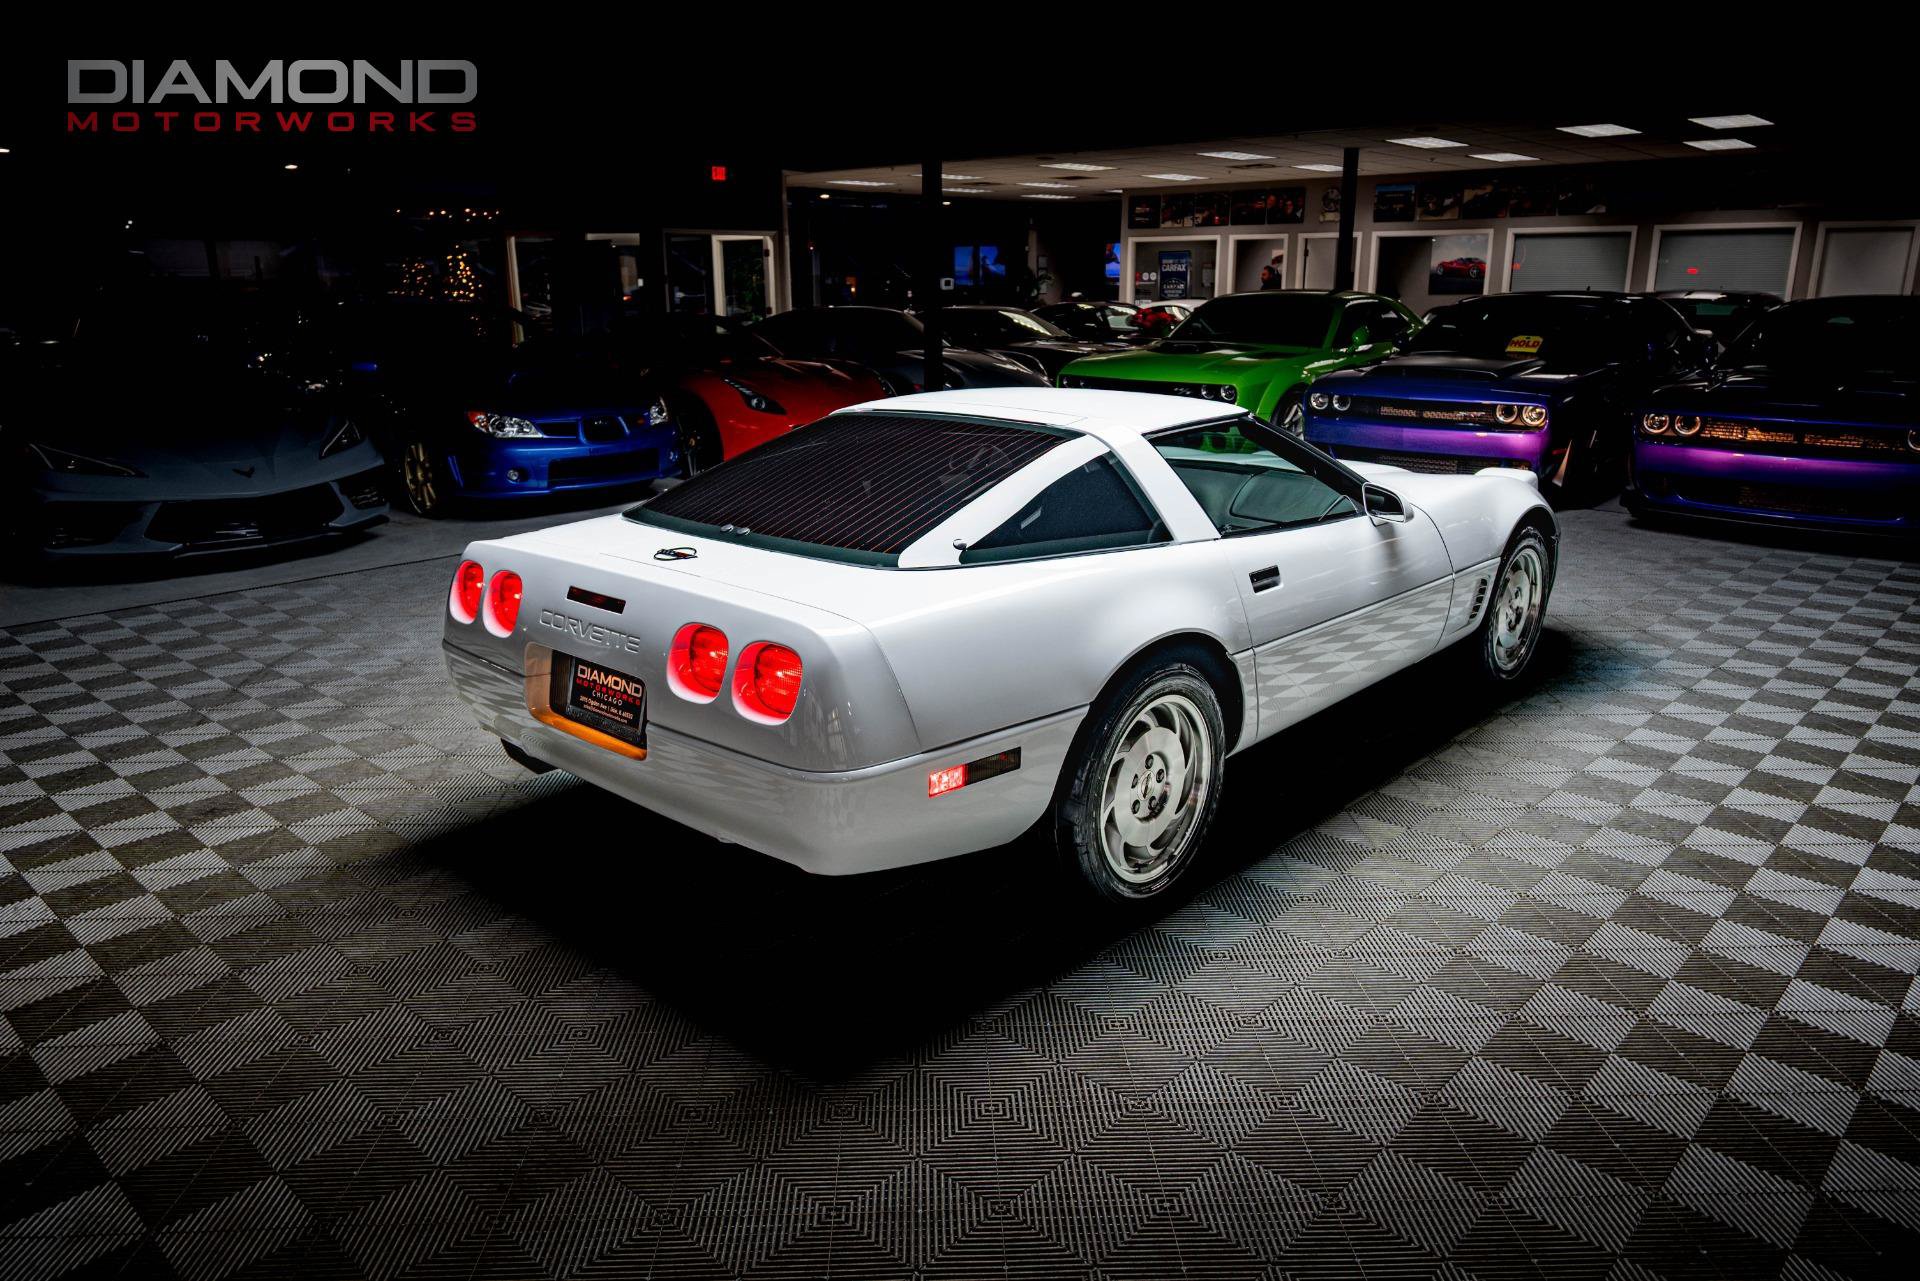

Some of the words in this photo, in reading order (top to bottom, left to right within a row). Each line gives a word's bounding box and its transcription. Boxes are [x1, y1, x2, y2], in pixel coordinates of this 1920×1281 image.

[1161, 264, 1187, 272] CARFAX
[1509, 339, 1540, 348] HOLD
[540, 608, 641, 654] CORVETTE
[577, 664, 643, 698] DIAMOND
[592, 689, 623, 706] CHICAGO
